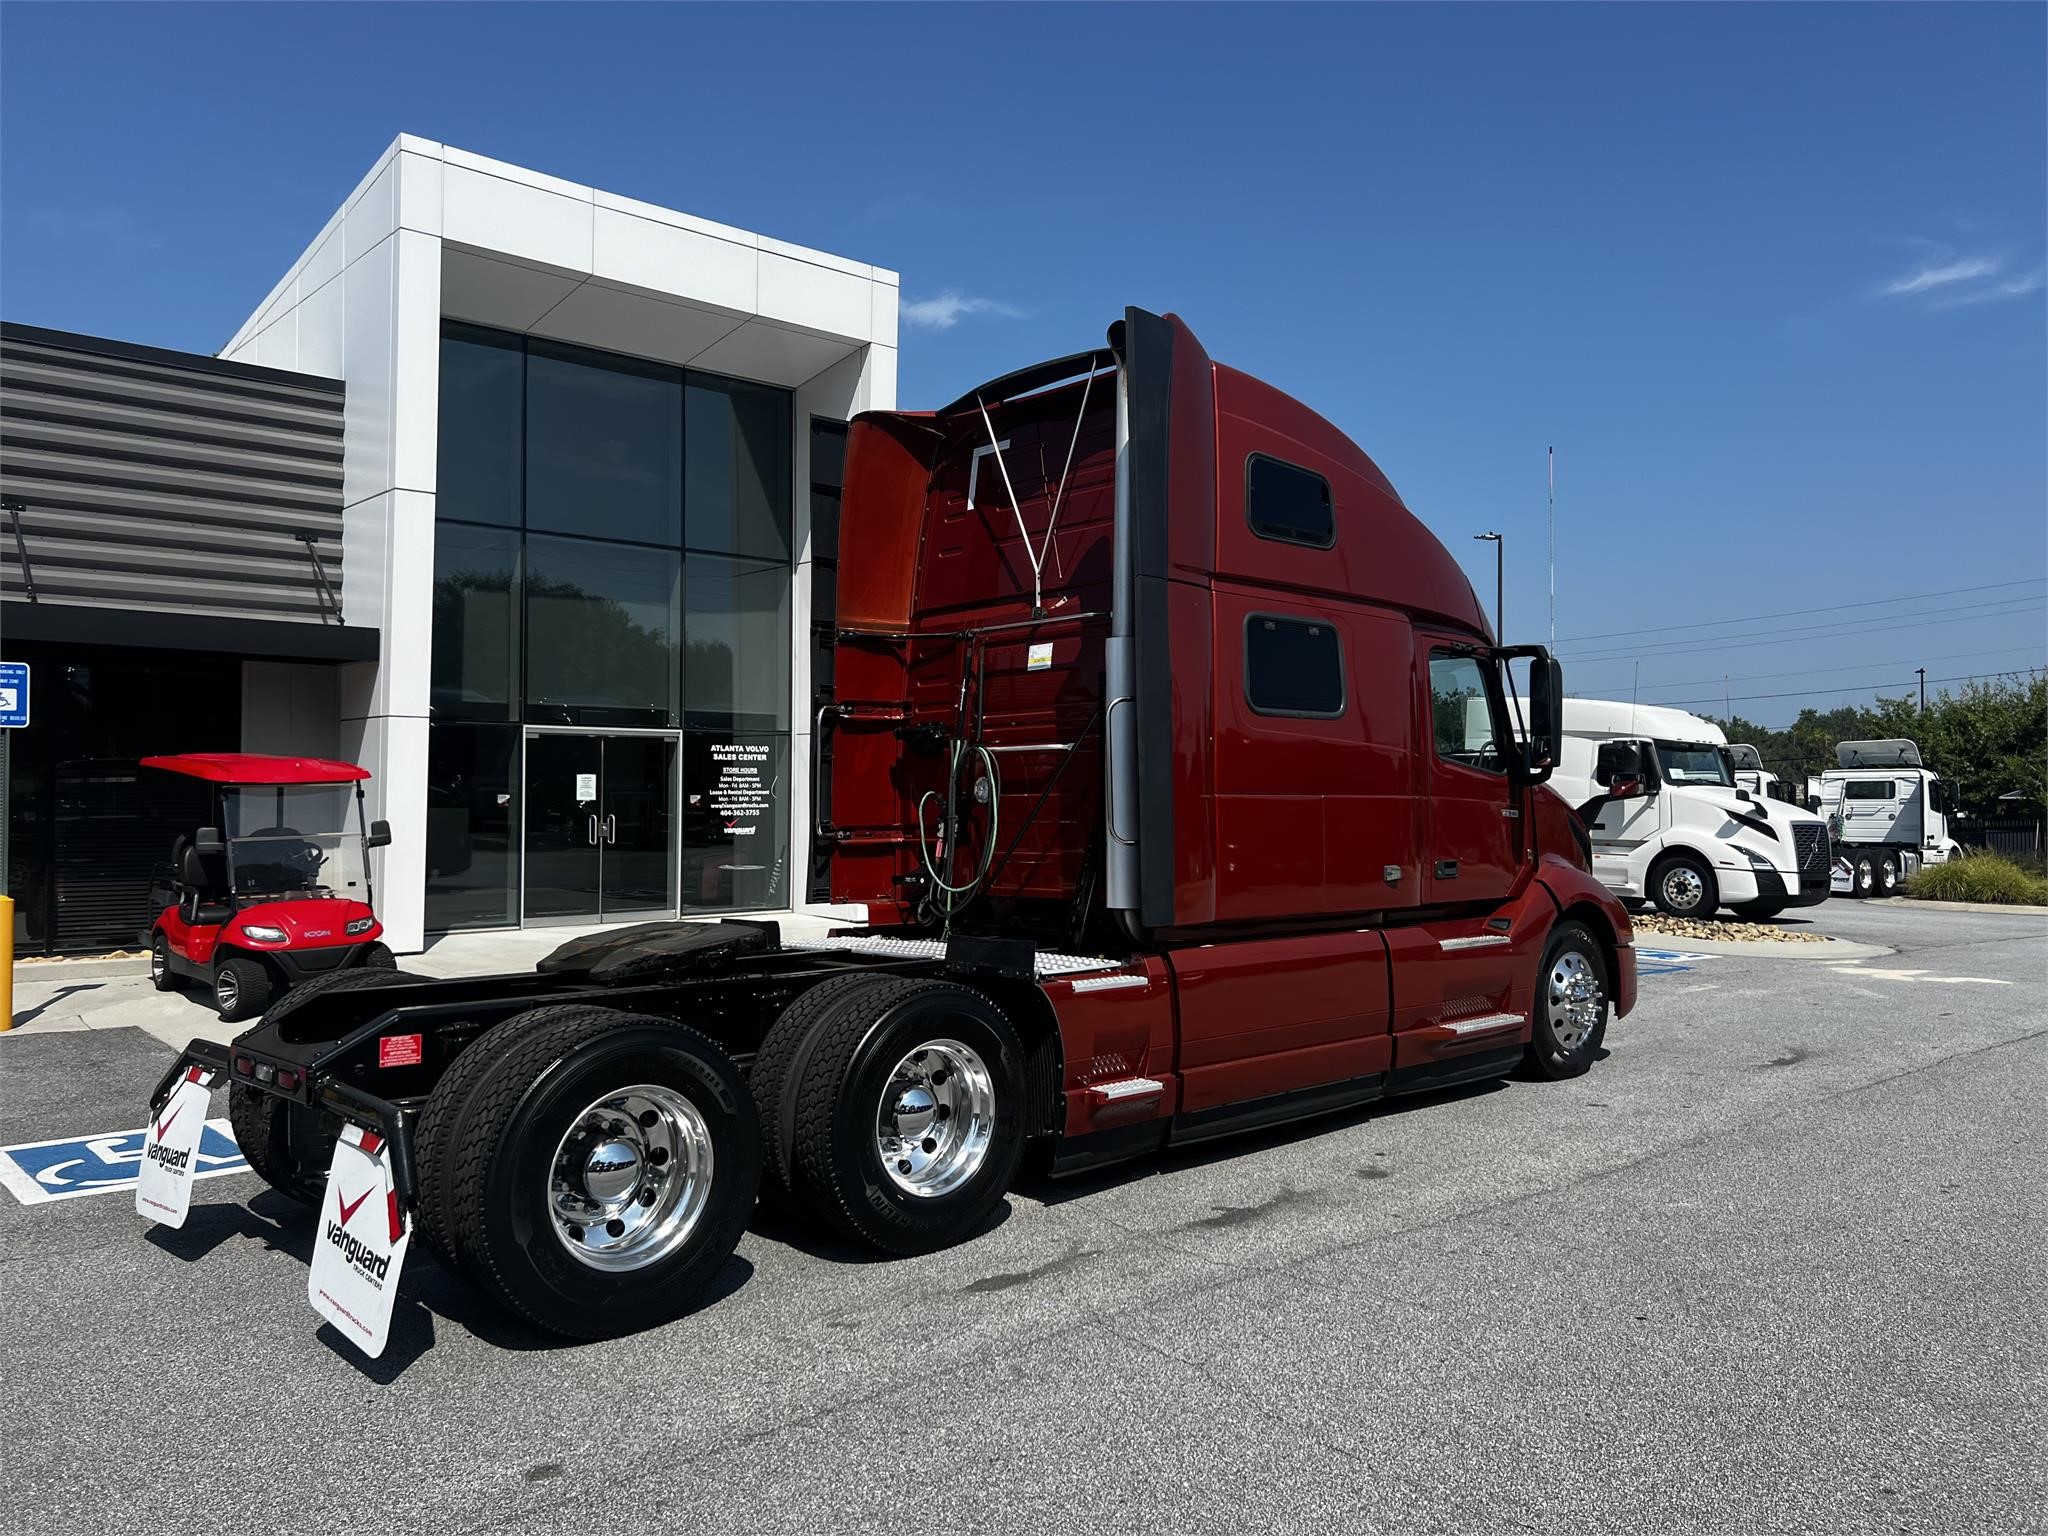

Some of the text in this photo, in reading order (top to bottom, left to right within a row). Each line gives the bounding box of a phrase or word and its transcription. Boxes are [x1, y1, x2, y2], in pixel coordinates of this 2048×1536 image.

[724, 826, 756, 834] vanguard
[147, 1142, 191, 1169] vanguard
[326, 1219, 392, 1282] vanguard
[353, 1263, 383, 1291] TRUCK CENTERS
